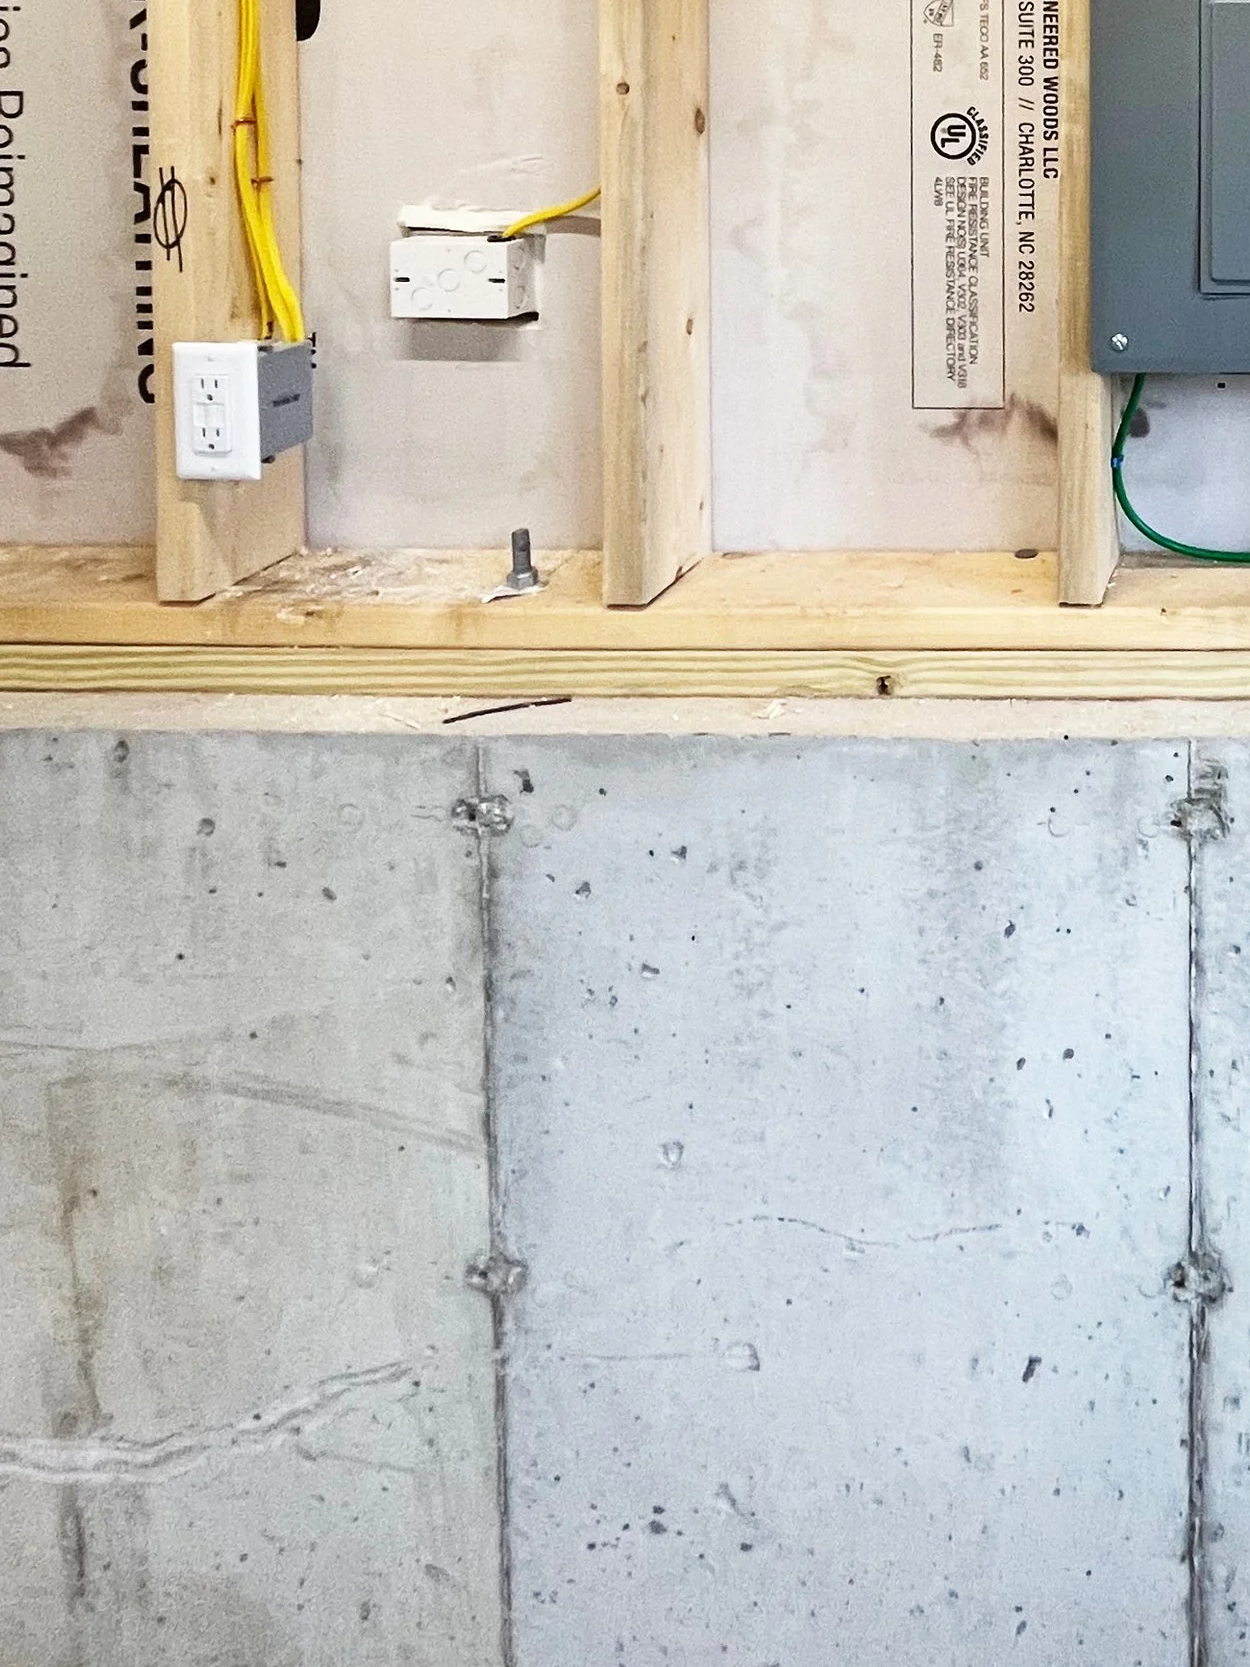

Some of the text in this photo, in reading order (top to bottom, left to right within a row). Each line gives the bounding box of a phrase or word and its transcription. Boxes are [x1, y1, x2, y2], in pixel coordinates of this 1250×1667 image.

[1018, 1, 1034, 48] SUITE
[1018, 55, 1034, 86] 300
[966, 107, 989, 166] CLASSIFIED
[1042, 77, 1059, 141] WOODS
[940, 125, 966, 149] UL
[1042, 147, 1059, 179] LLC
[1016, 123, 1034, 225] CHARLOTTE,
[946, 218, 956, 243] FIRE
[980, 177, 989, 257] BUILDING UNIT
[1018, 232, 1034, 255] NC
[946, 246, 956, 315] RESISTANCE
[968, 177, 978, 365] FIRE RESISTANCE CLASSIFICATION
[1018, 261, 1034, 313] 28262
[946, 317, 956, 381] DIRECTORY
